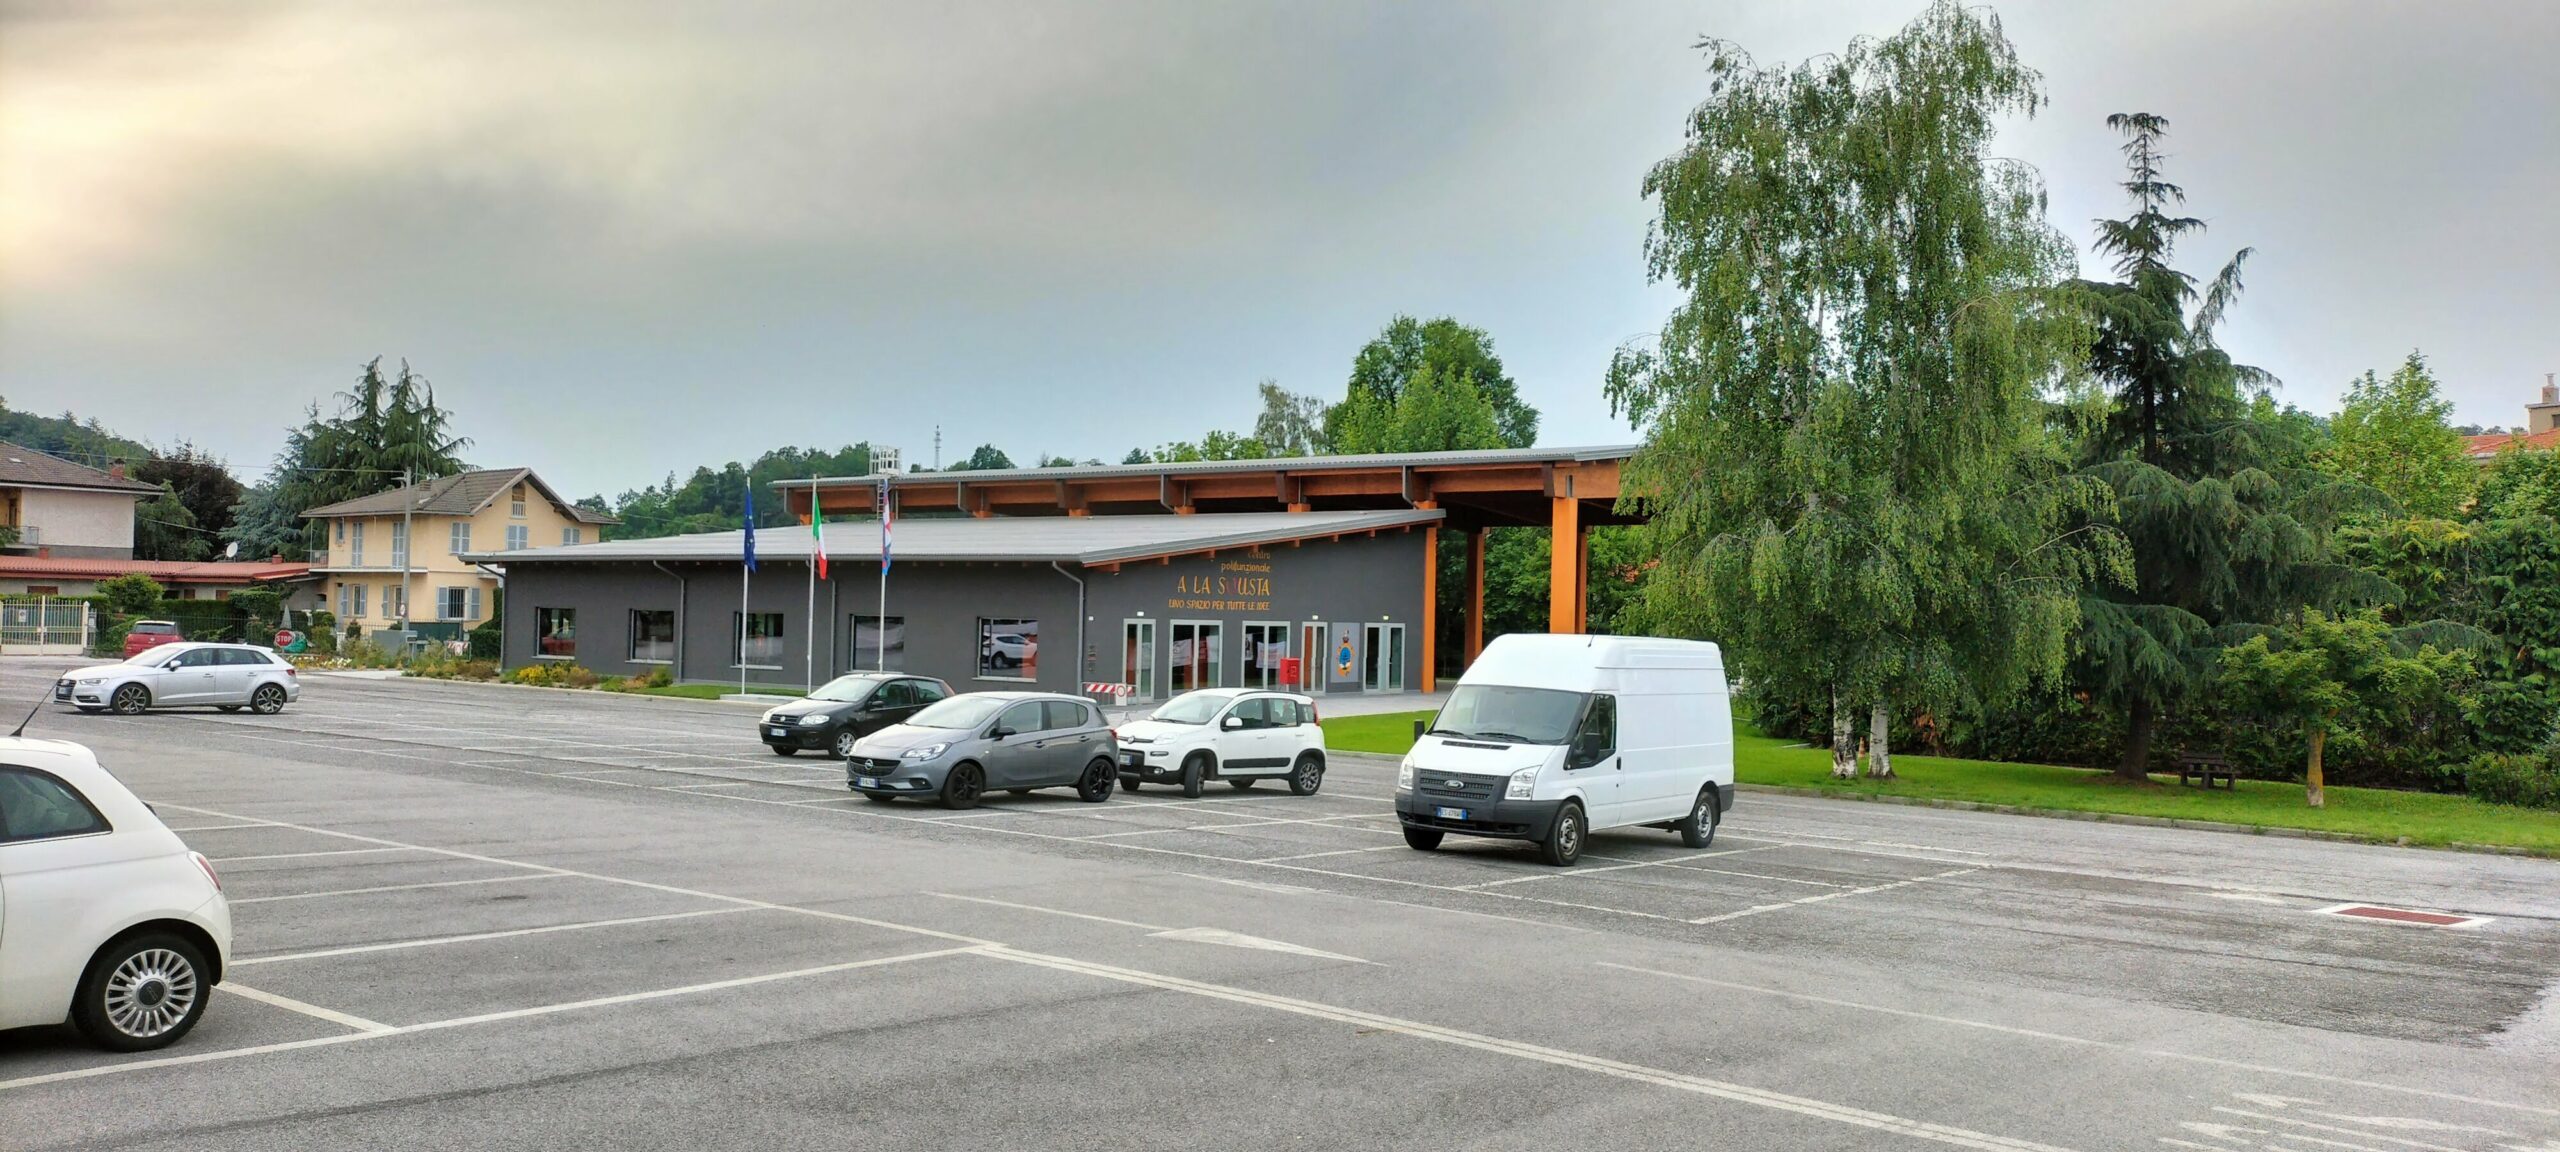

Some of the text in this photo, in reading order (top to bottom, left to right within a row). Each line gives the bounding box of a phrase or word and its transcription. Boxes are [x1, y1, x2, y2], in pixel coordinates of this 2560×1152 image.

[1221, 560, 1271, 573] polifunzionale
[1177, 575, 1187, 593] A
[1193, 575, 1211, 595] LA
[1186, 599, 1211, 610] SPAZIO
[1212, 600, 1225, 611] PER
[1227, 600, 1247, 611] TUTTE
[1248, 601, 1256, 611] LE
